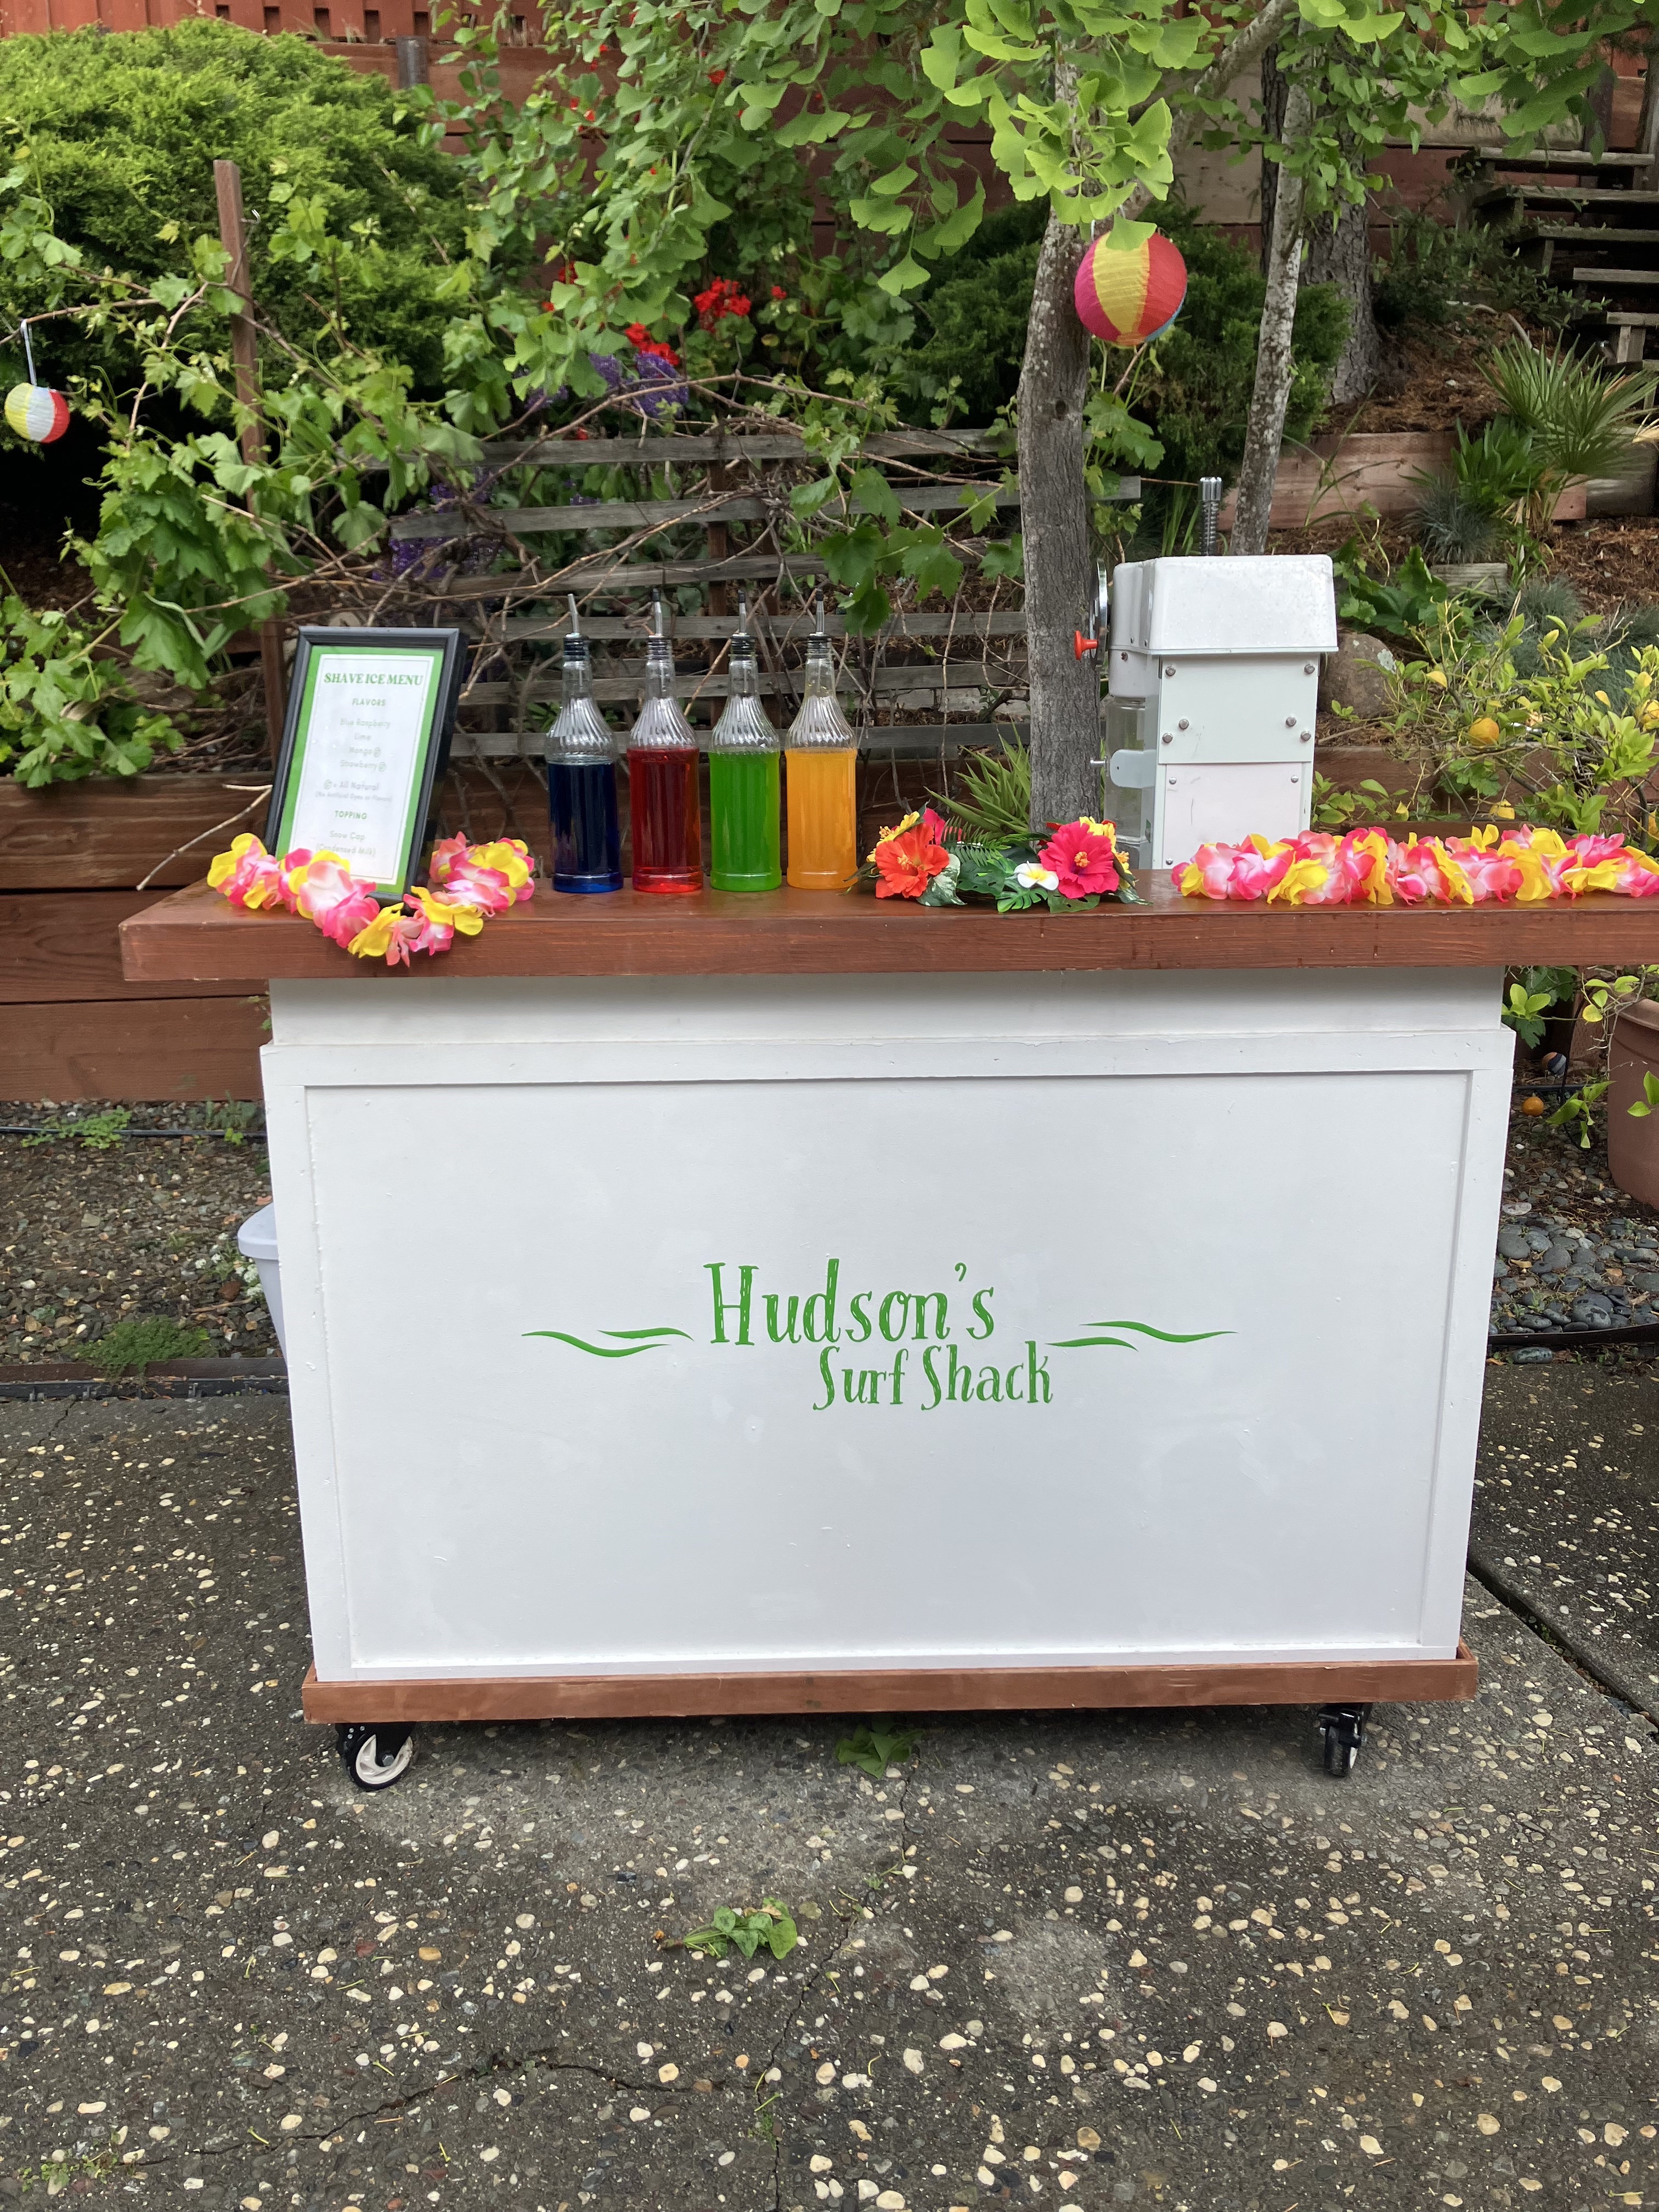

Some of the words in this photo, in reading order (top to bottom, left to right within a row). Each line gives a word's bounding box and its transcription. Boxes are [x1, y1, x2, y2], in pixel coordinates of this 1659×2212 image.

[324, 673, 364, 684] SHAVE
[364, 674, 386, 685] ICE
[386, 674, 424, 686] MENU
[352, 697, 386, 707] FLAVORS
[349, 746, 374, 756] Mango
[351, 781, 380, 791] Natural
[335, 810, 368, 820] TOPPING
[330, 830, 348, 839] Snow
[349, 832, 365, 843] Cap
[703, 1258, 995, 1347] Hudson's
[812, 1345, 909, 1410] Surf
[921, 1340, 1053, 1410] Shack
